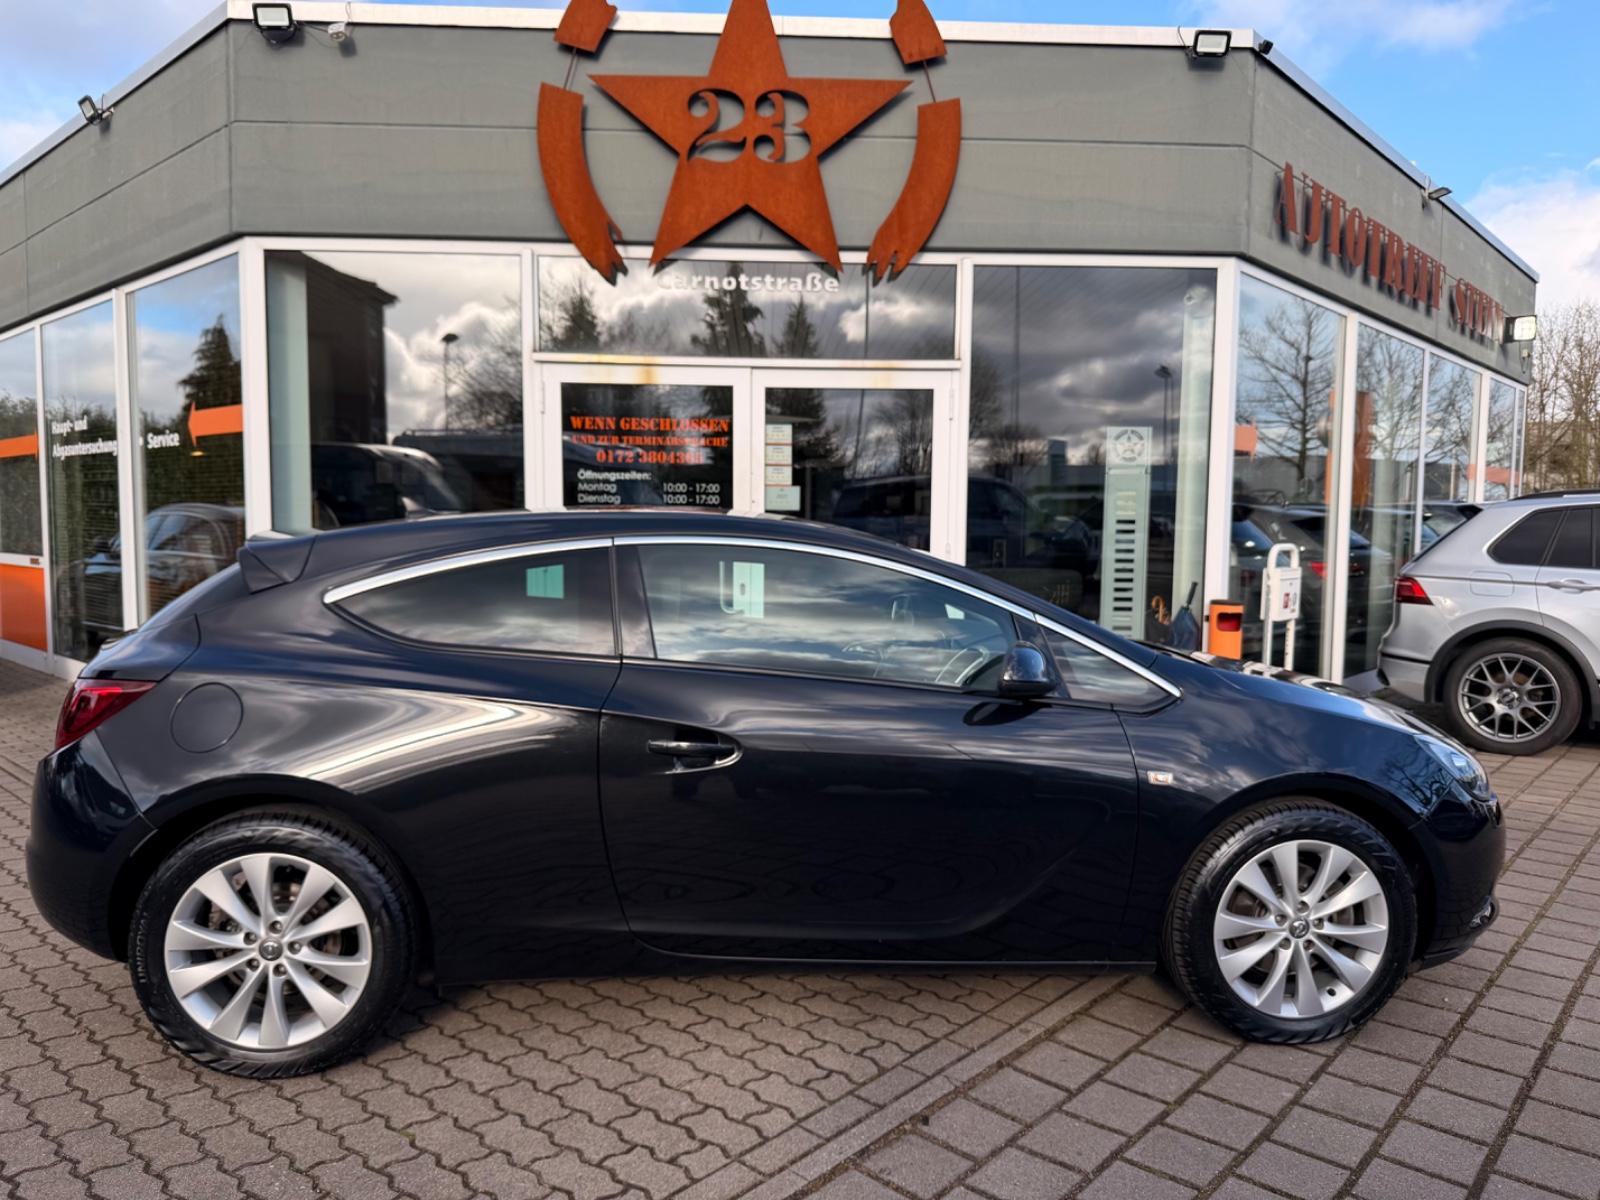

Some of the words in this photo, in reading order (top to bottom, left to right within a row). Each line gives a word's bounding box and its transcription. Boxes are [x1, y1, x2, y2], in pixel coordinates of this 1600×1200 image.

[687, 88, 812, 164] 23
[570, 416, 616, 430] WENN
[619, 417, 729, 432] GESCHLOSSEN
[147, 429, 180, 449] Service
[596, 449, 634, 463] 0172
[577, 469, 652, 481] Öffnungszeiten:
[577, 483, 617, 493] Montag
[663, 483, 687, 493] 10:00
[696, 483, 720, 493] 17:00
[577, 494, 621, 504] Dienstag
[663, 494, 687, 505] 10:00
[696, 495, 720, 505] 17:00
